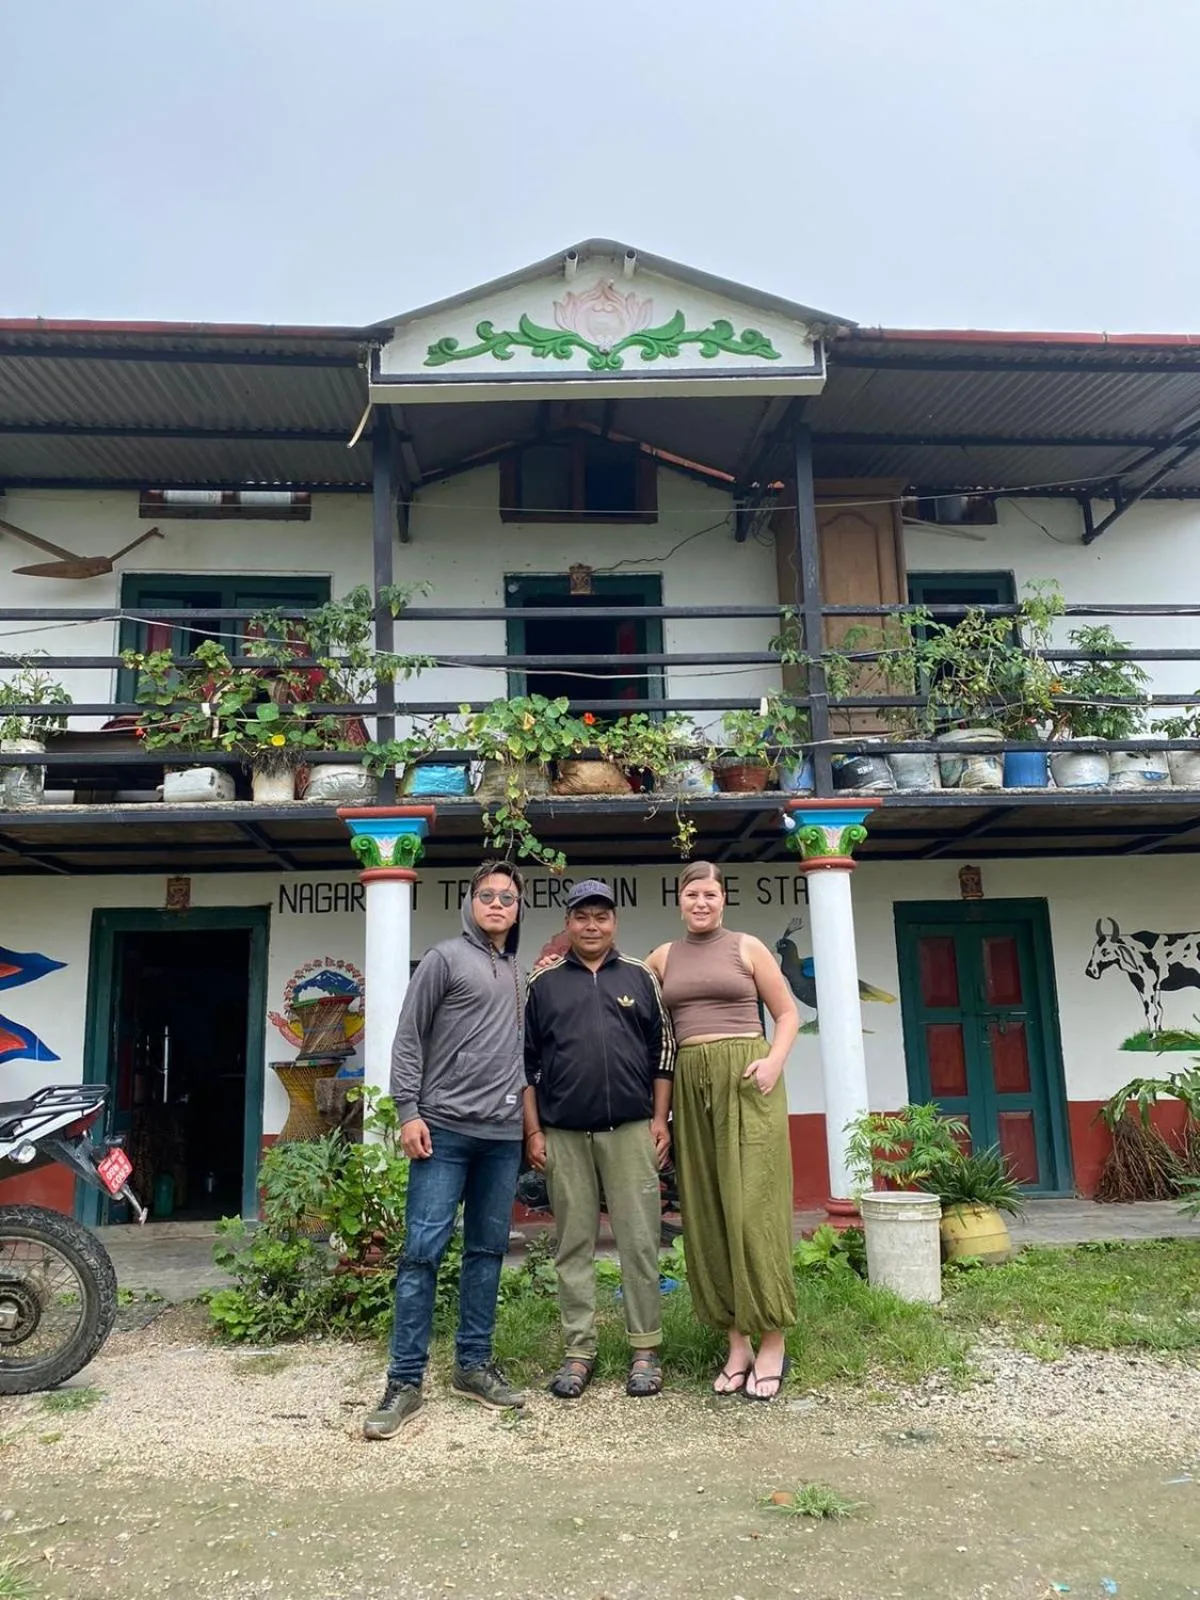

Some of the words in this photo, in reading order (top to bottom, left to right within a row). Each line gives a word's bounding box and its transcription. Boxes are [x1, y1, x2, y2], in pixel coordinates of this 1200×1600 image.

[279, 880, 423, 914] NAGART
[662, 876, 740, 906] HE
[756, 876, 809, 905] STA
